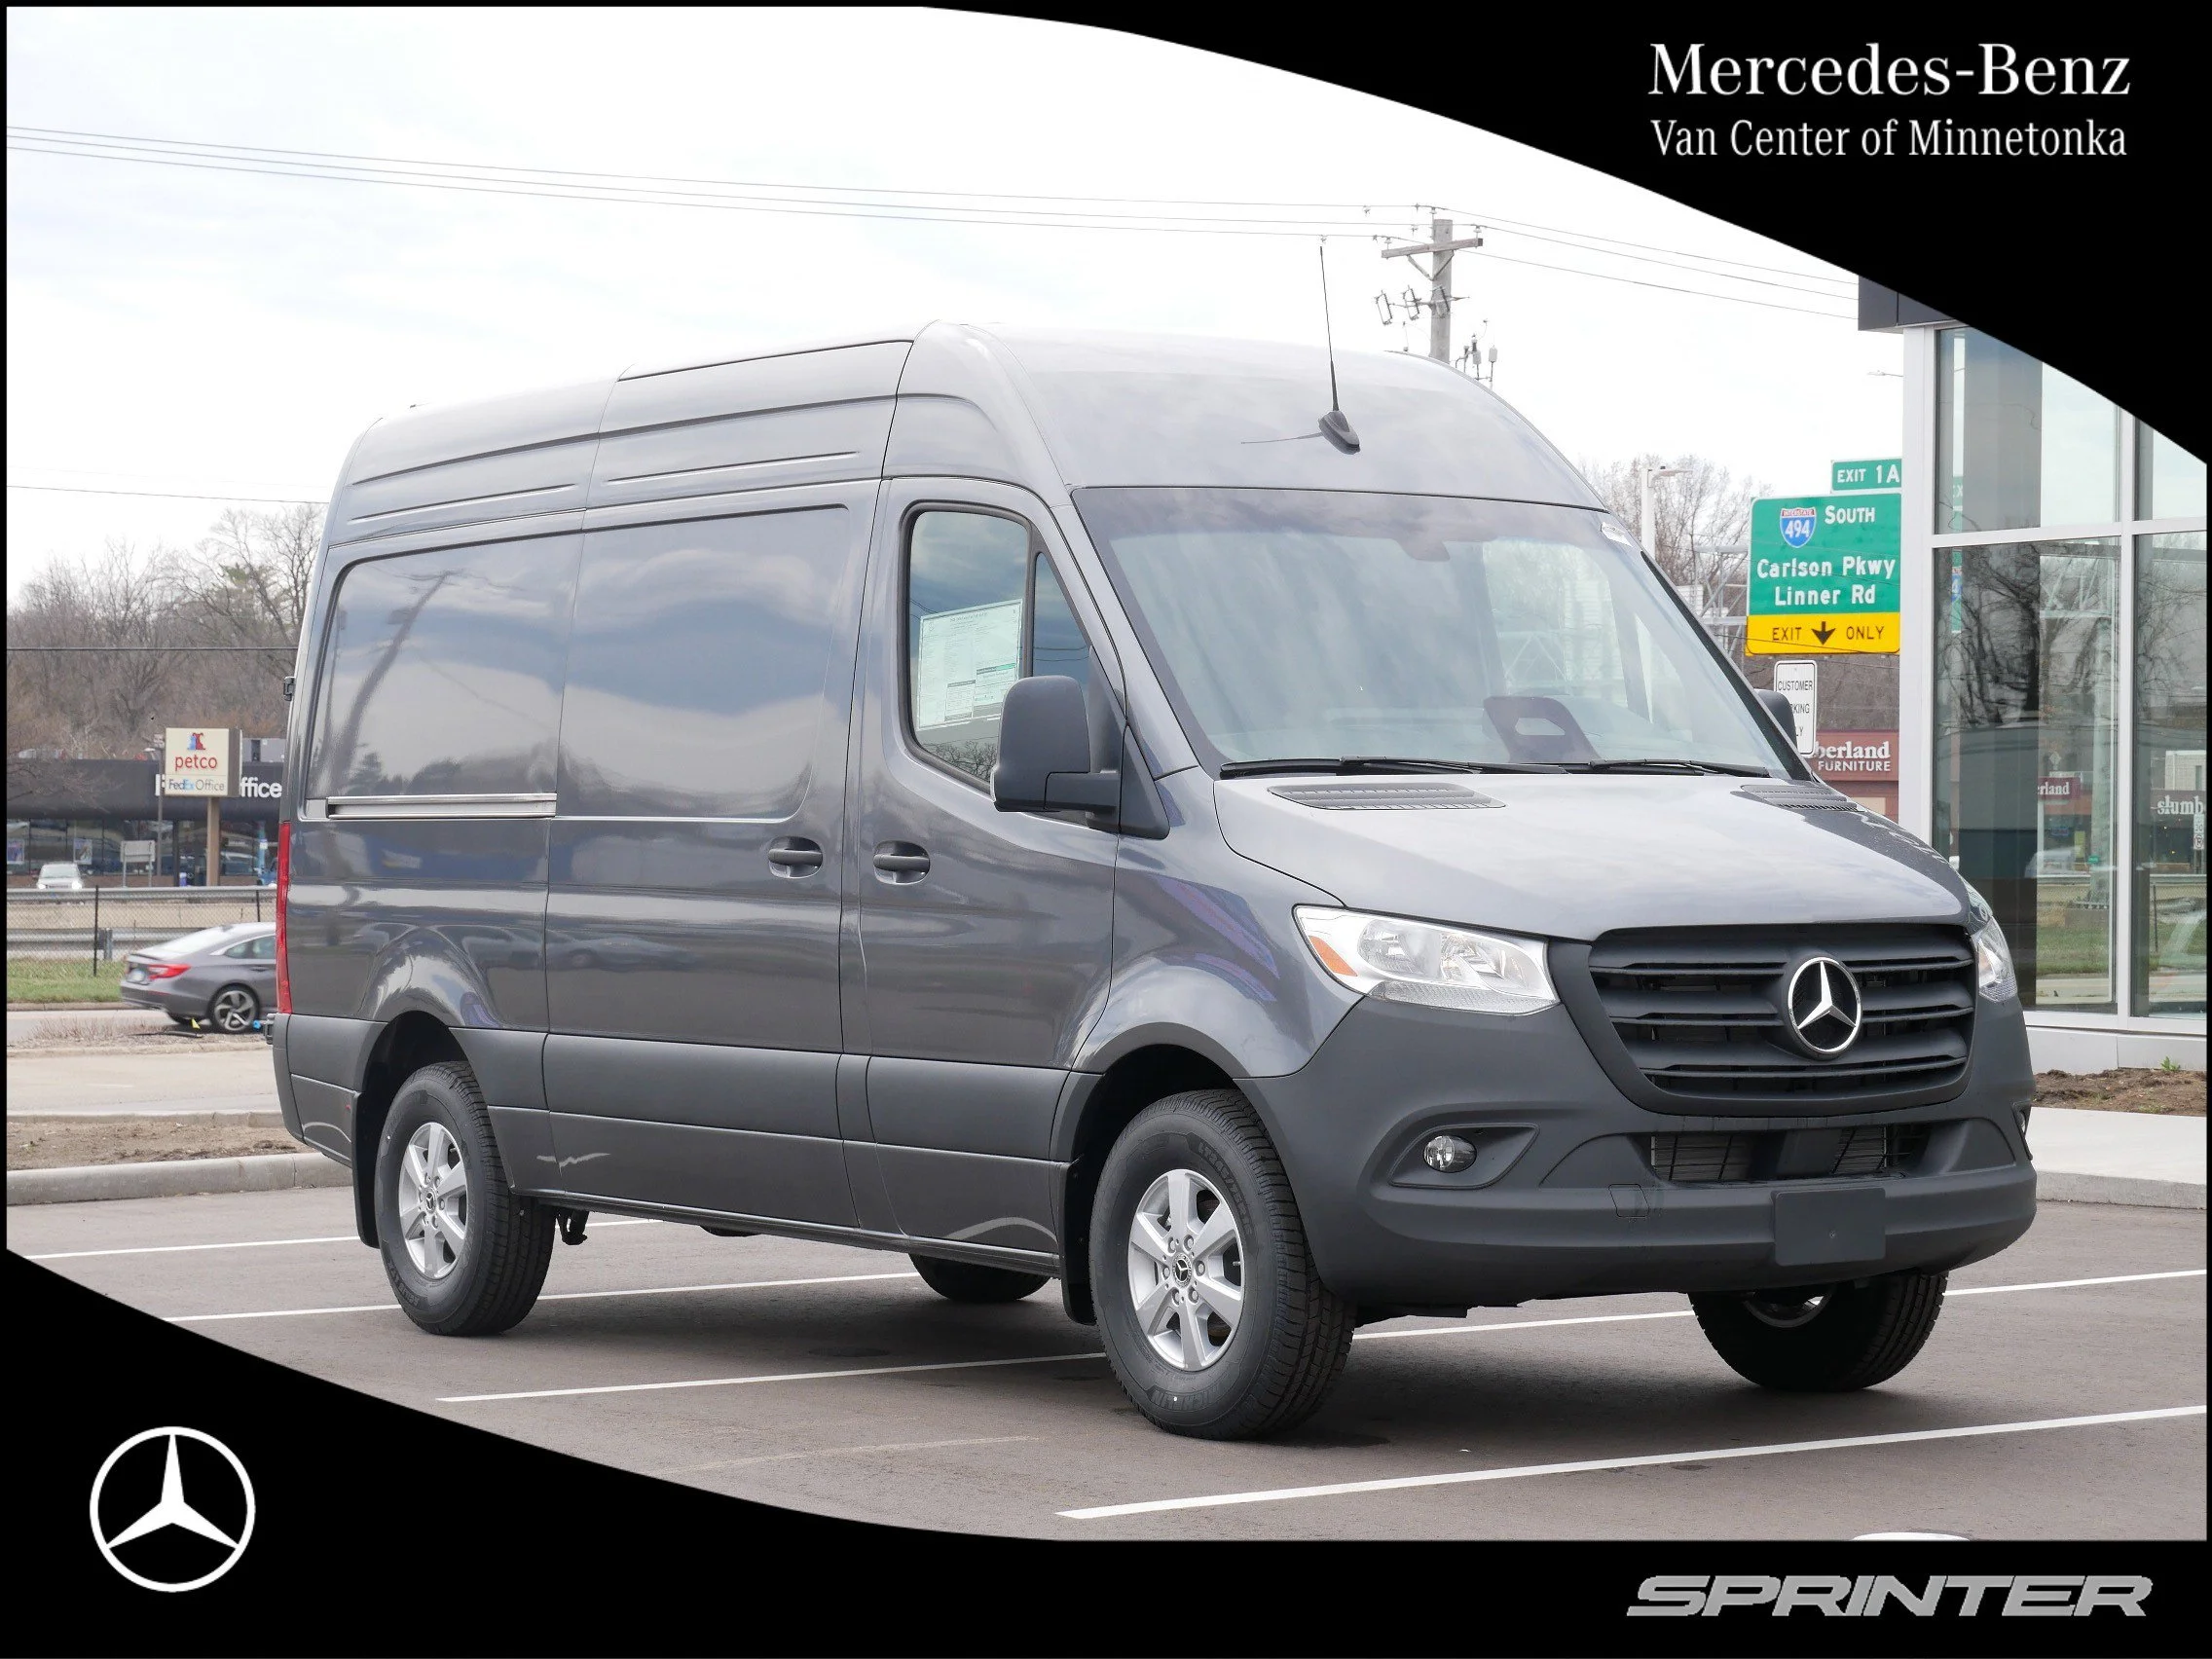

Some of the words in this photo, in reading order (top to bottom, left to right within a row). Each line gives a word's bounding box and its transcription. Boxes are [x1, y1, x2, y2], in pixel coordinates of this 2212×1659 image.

[1837, 468, 1866, 483] EXIT
[1876, 464, 1900, 484] 1A
[1825, 504, 1876, 525] SOUTH
[1785, 519, 1810, 538] 494
[1756, 558, 1832, 578] Carlson
[1842, 556, 1896, 579] Pkwy
[1775, 586, 1841, 606] Linner
[1851, 584, 1876, 605] Rd
[1772, 627, 1802, 641] EXIT
[1846, 626, 1884, 640] ONLY
[1778, 680, 1813, 691] CUSTOMER
[1814, 741, 1891, 759] berland
[175, 755, 217, 771] petco
[1818, 760, 1892, 772] FURNITURE
[168, 779, 195, 791] FedEx
[195, 779, 225, 792] Office
[240, 777, 282, 798] ffice
[2038, 782, 2070, 795] rland
[2157, 794, 2205, 815] slumb
